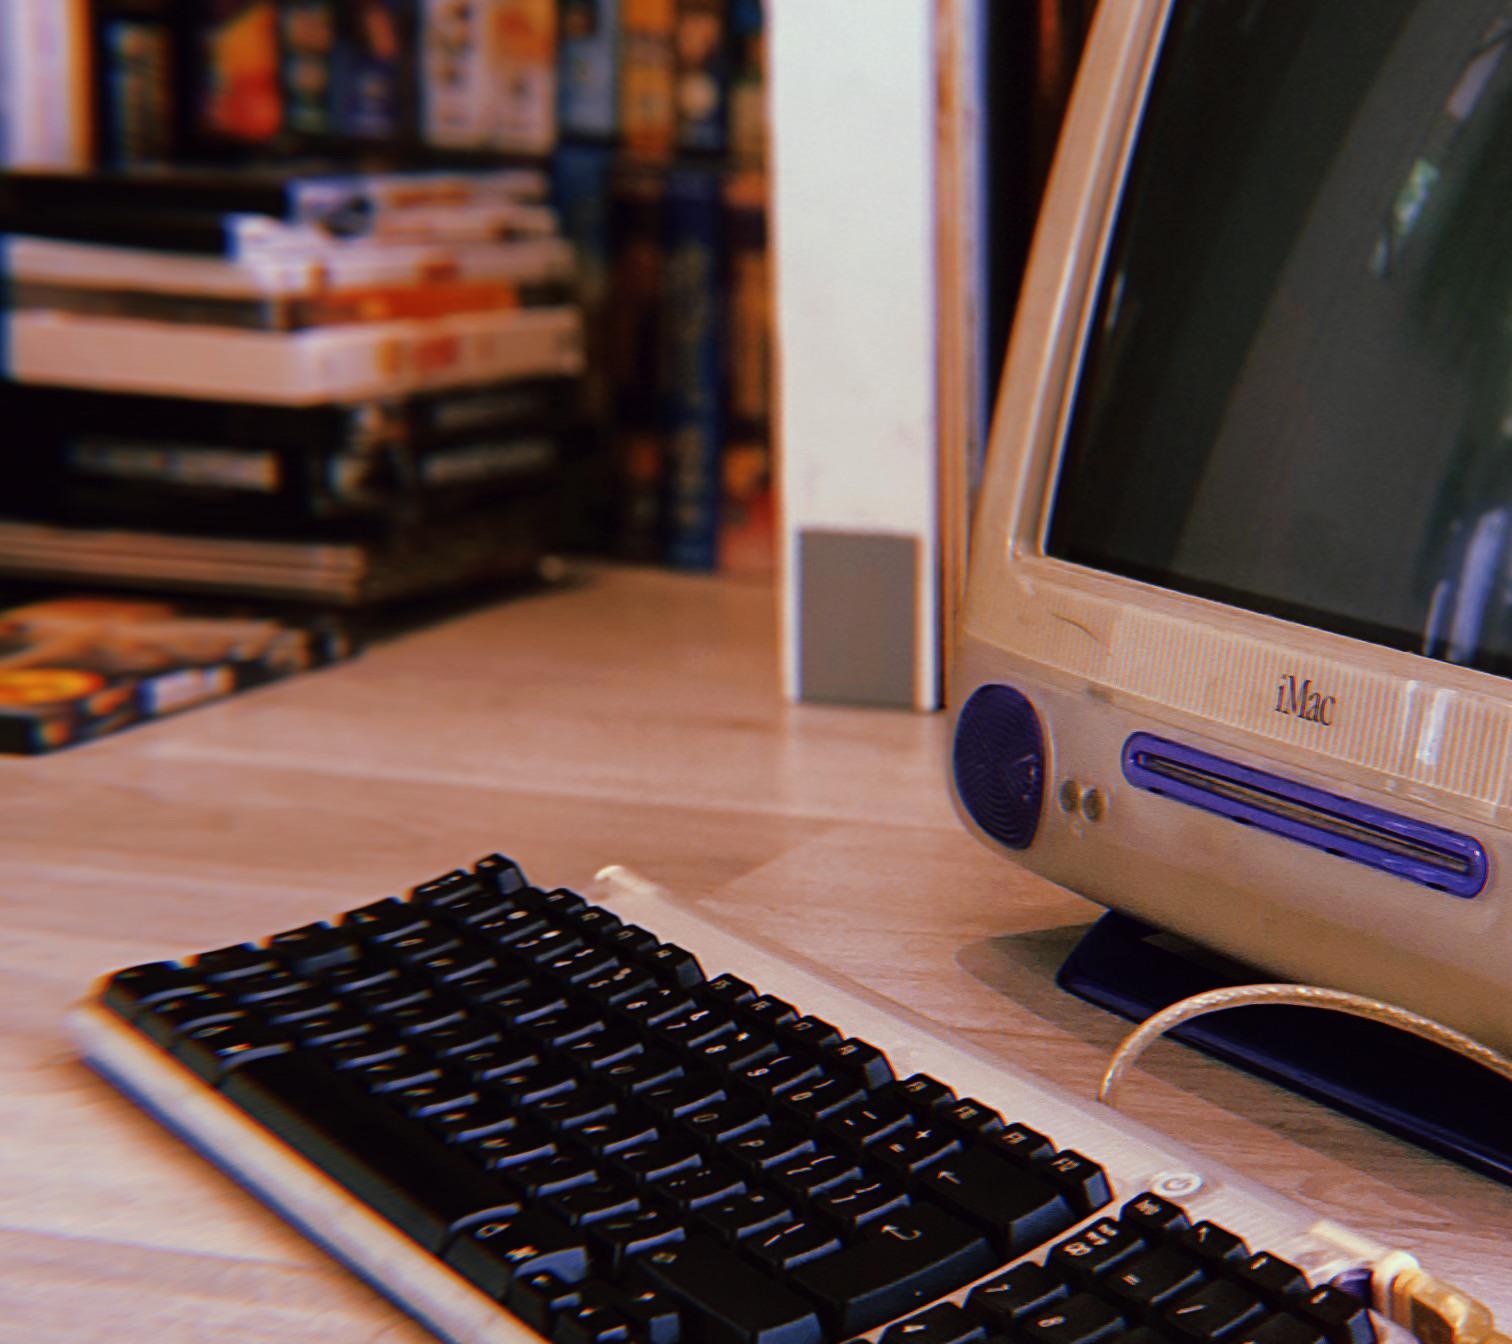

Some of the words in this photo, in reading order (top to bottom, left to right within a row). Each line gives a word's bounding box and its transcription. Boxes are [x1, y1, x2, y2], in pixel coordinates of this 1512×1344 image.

[1274, 672, 1336, 726] iMac
[984, 1283, 1011, 1293] 7
[1037, 1315, 1066, 1327] 8
